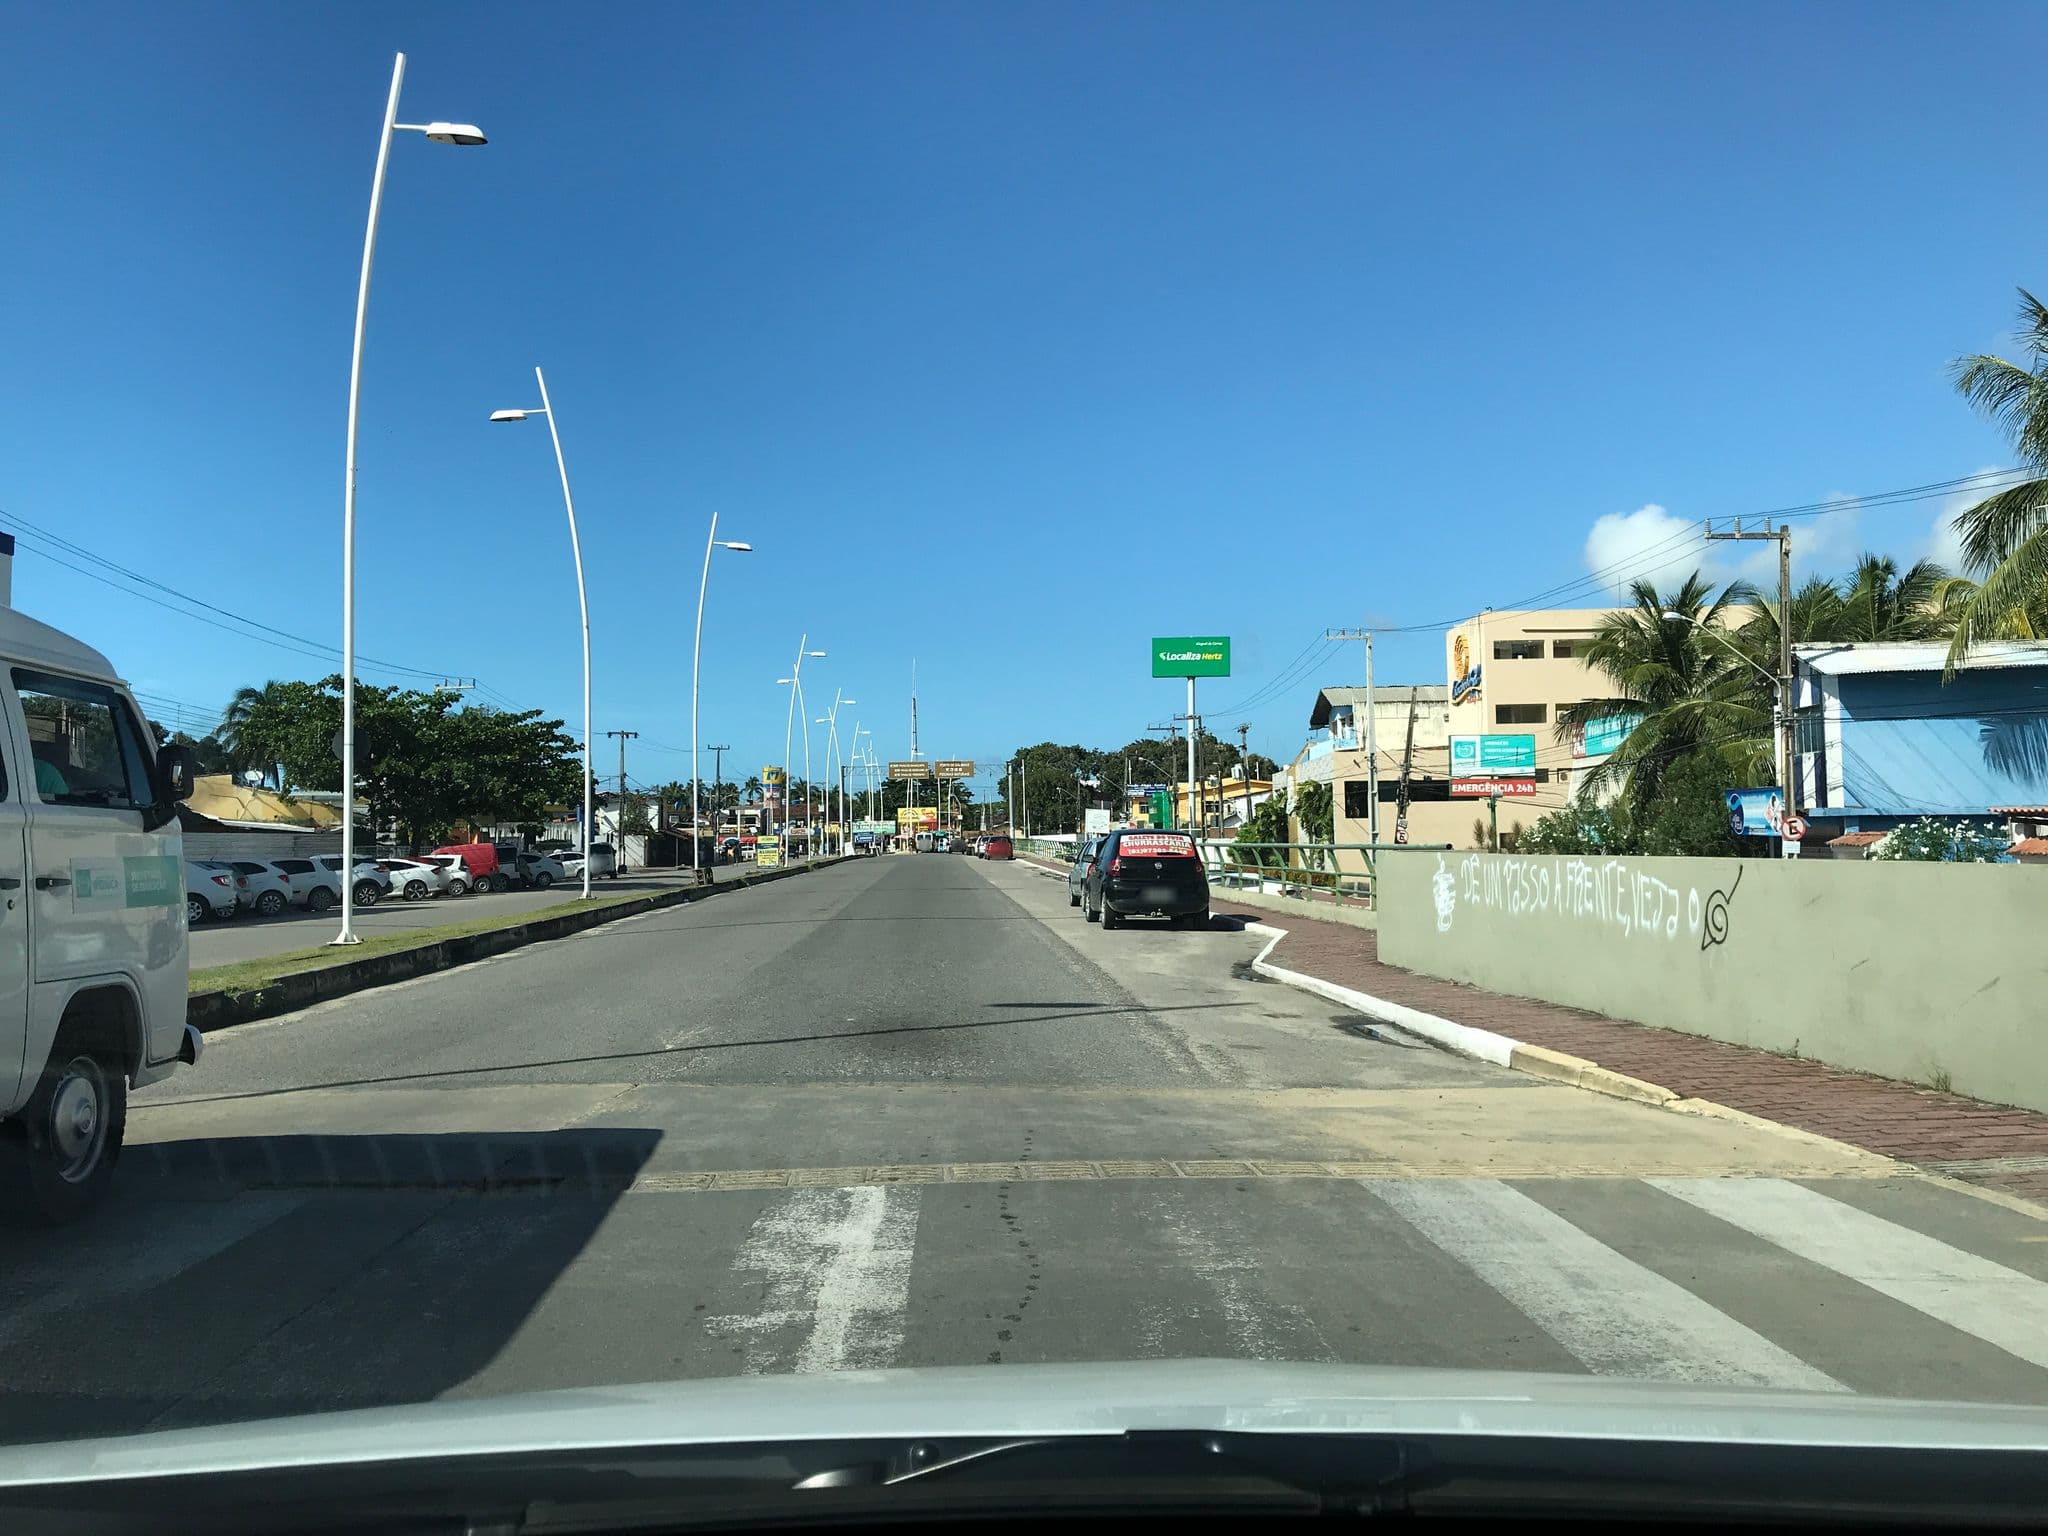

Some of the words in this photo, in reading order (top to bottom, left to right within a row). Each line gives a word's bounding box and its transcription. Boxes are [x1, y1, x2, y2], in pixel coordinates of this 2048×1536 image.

[1166, 651, 1201, 661] Localiza
[1201, 652, 1223, 661] Hertz
[1452, 782, 1515, 793] EMERGÊNCIA
[1516, 784, 1534, 793] 24h
[1123, 840, 1191, 849] CHURRASCARIA
[1484, 861, 1502, 909] UM
[1554, 859, 1562, 913] A
